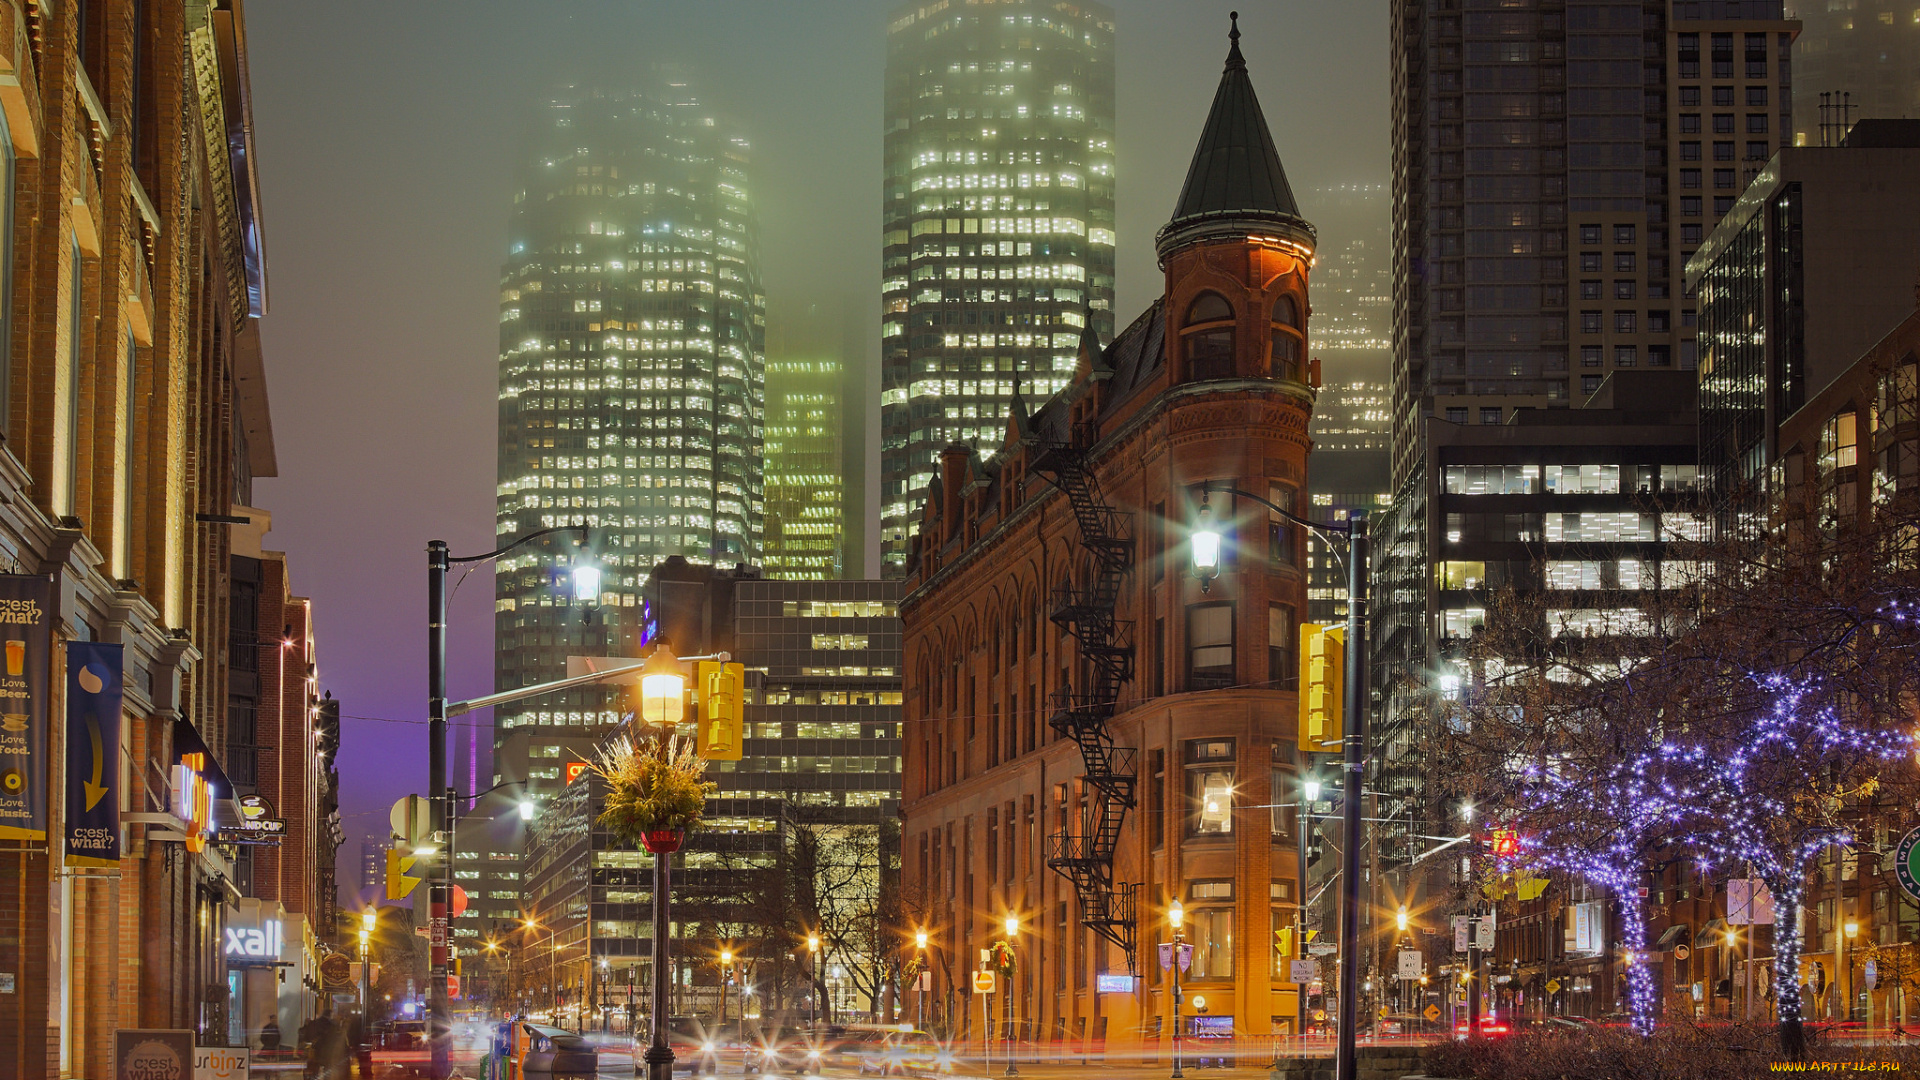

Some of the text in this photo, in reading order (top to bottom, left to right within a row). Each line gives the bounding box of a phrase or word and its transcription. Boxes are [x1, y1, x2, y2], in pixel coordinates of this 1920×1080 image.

[2, 678, 28, 688] Love.
[1, 735, 28, 745] Love.
[70, 835, 115, 850] what?
[1404, 953, 1416, 961] ONE
[1298, 962, 1308, 970] NO
